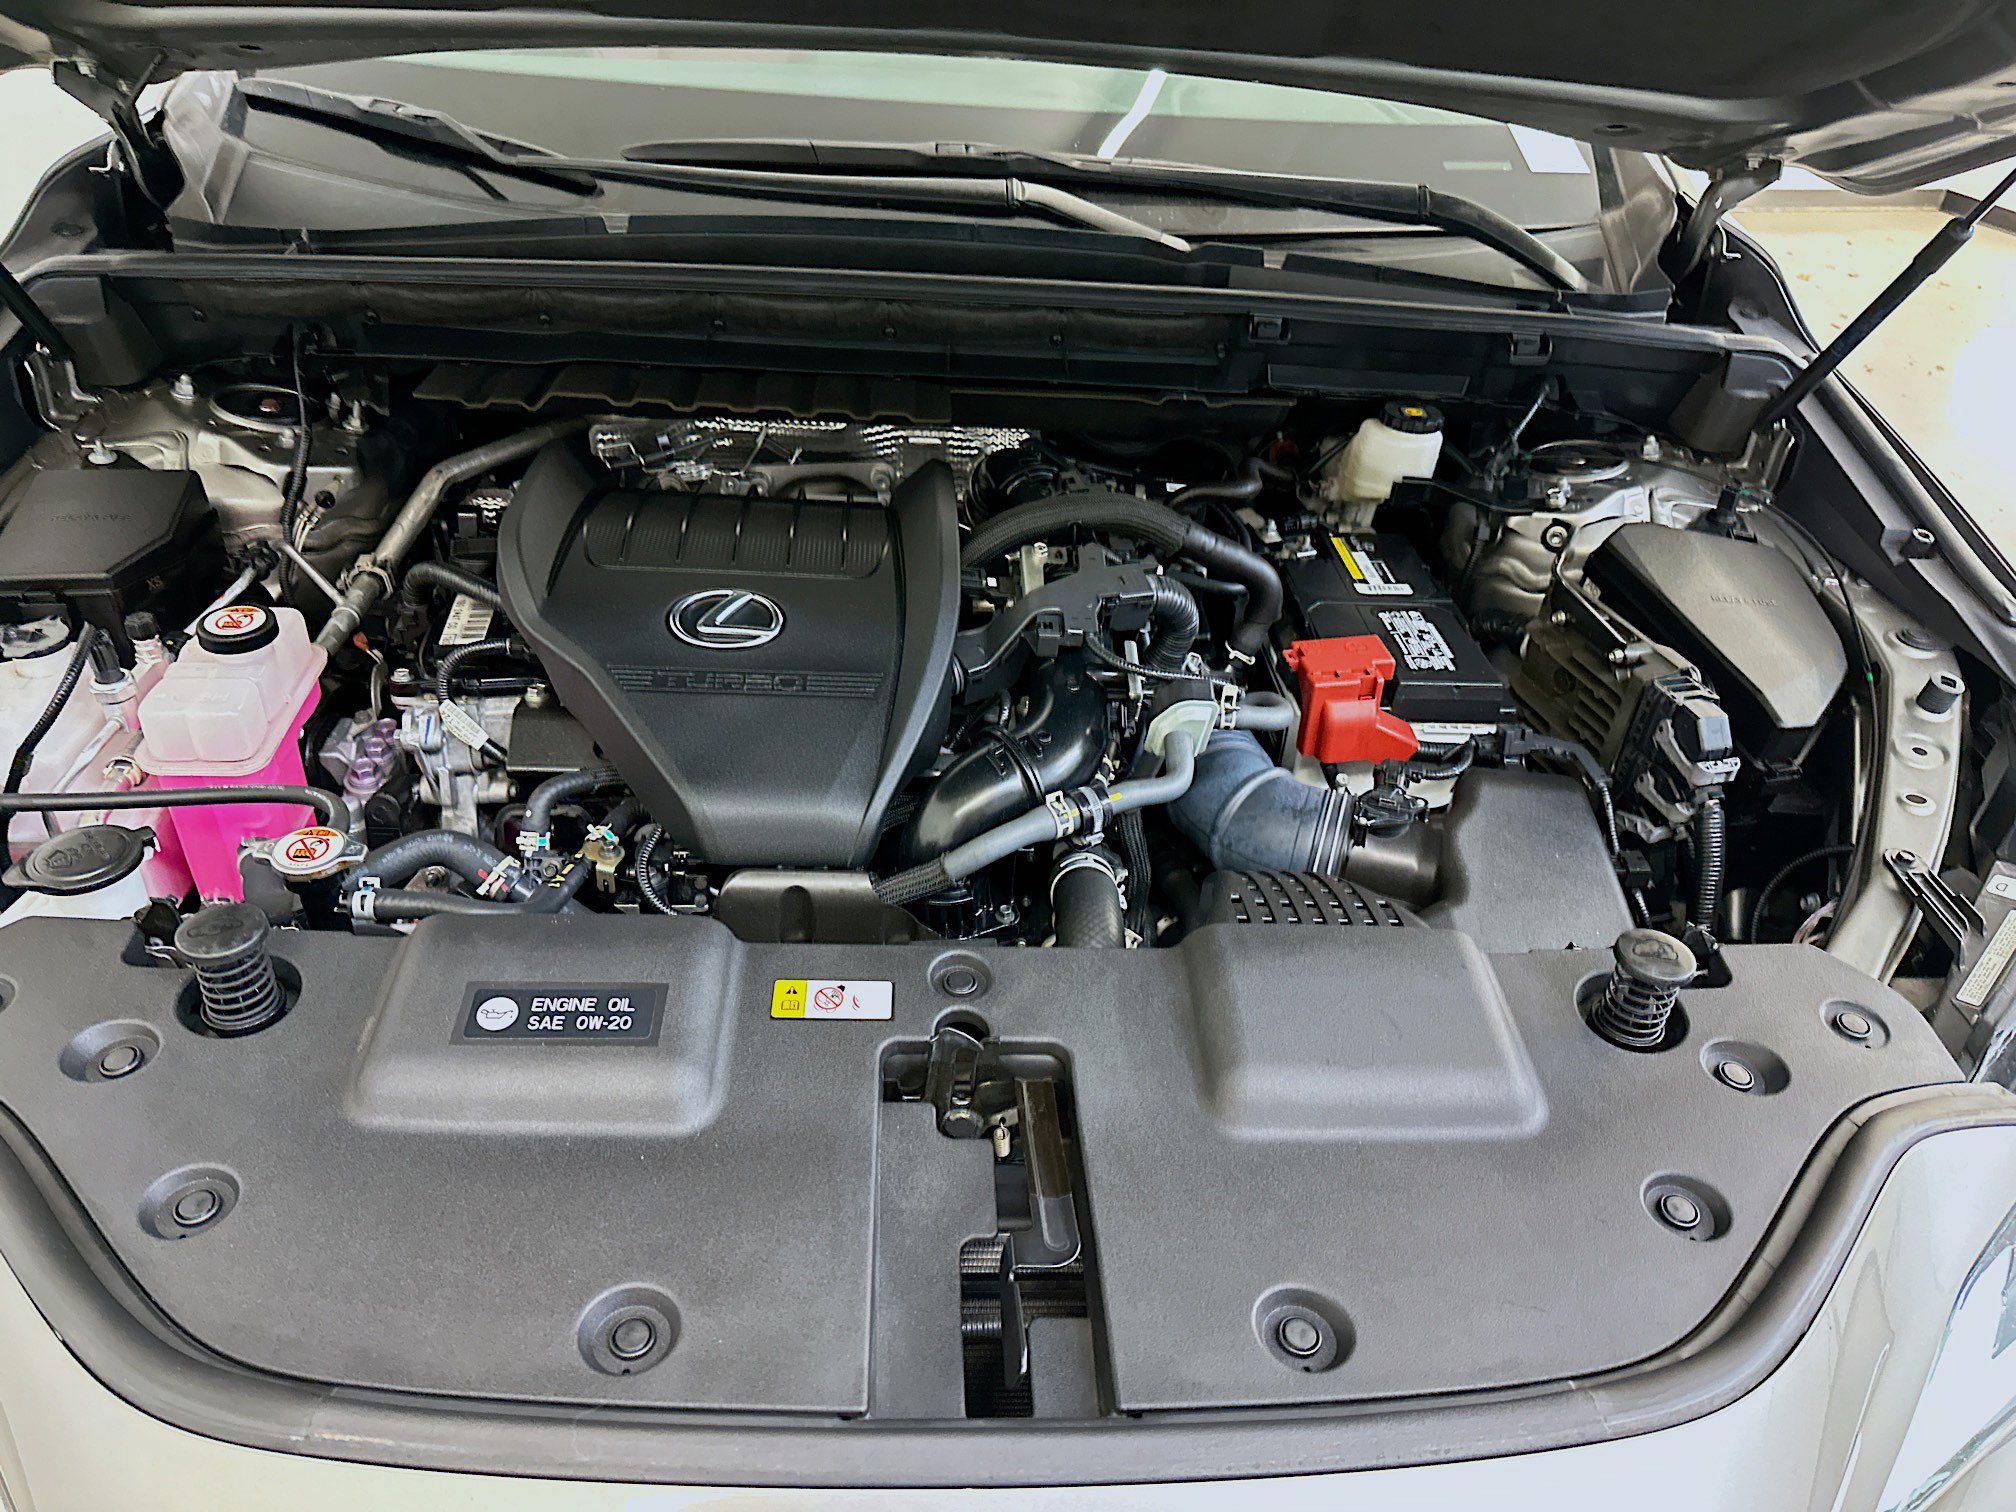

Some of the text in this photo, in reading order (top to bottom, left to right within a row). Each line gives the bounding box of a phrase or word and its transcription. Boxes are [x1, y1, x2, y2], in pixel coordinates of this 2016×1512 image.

[656, 671, 802, 692] TURBO
[531, 998, 636, 1013] ENGINE OIL
[527, 1016, 633, 1030] SAE 0W-20
